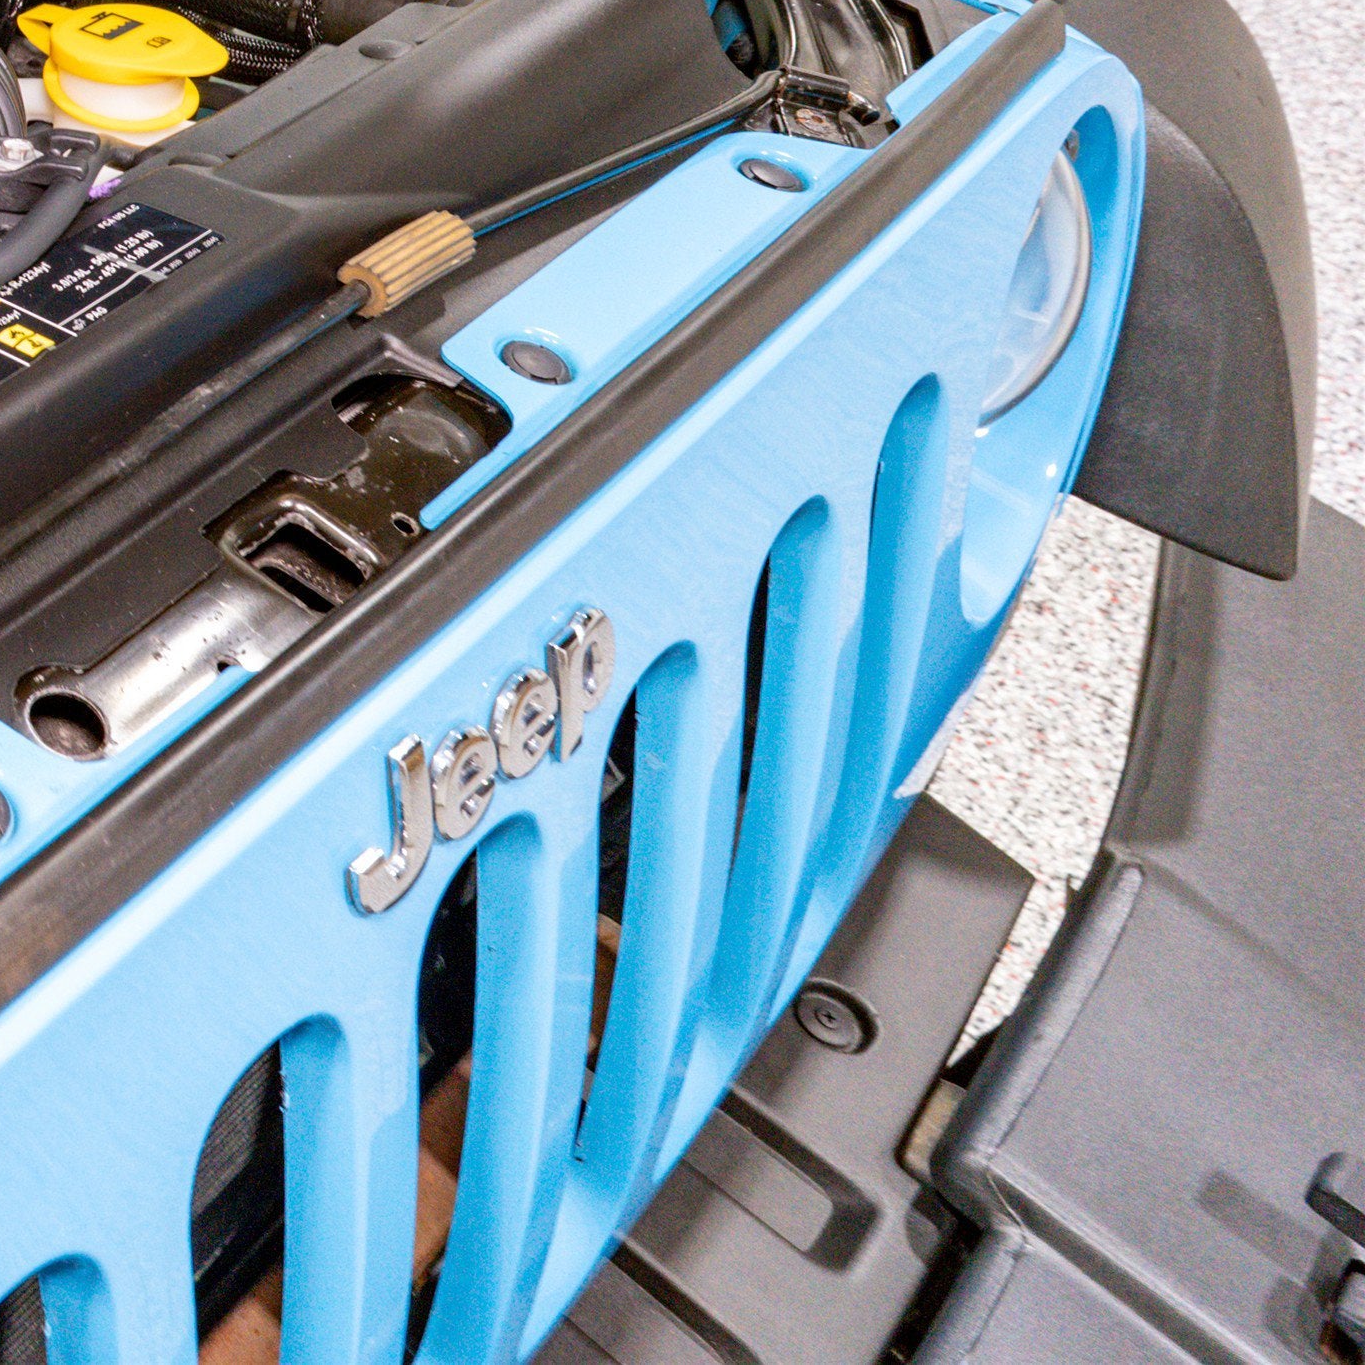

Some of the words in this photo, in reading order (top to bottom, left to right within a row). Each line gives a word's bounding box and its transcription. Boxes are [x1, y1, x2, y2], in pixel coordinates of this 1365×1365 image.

[97, 217, 115, 229] FCA
[113, 211, 126, 223] US
[123, 203, 140, 216] LLC
[85, 306, 108, 322] PAG
[346, 606, 616, 914] Jeep
